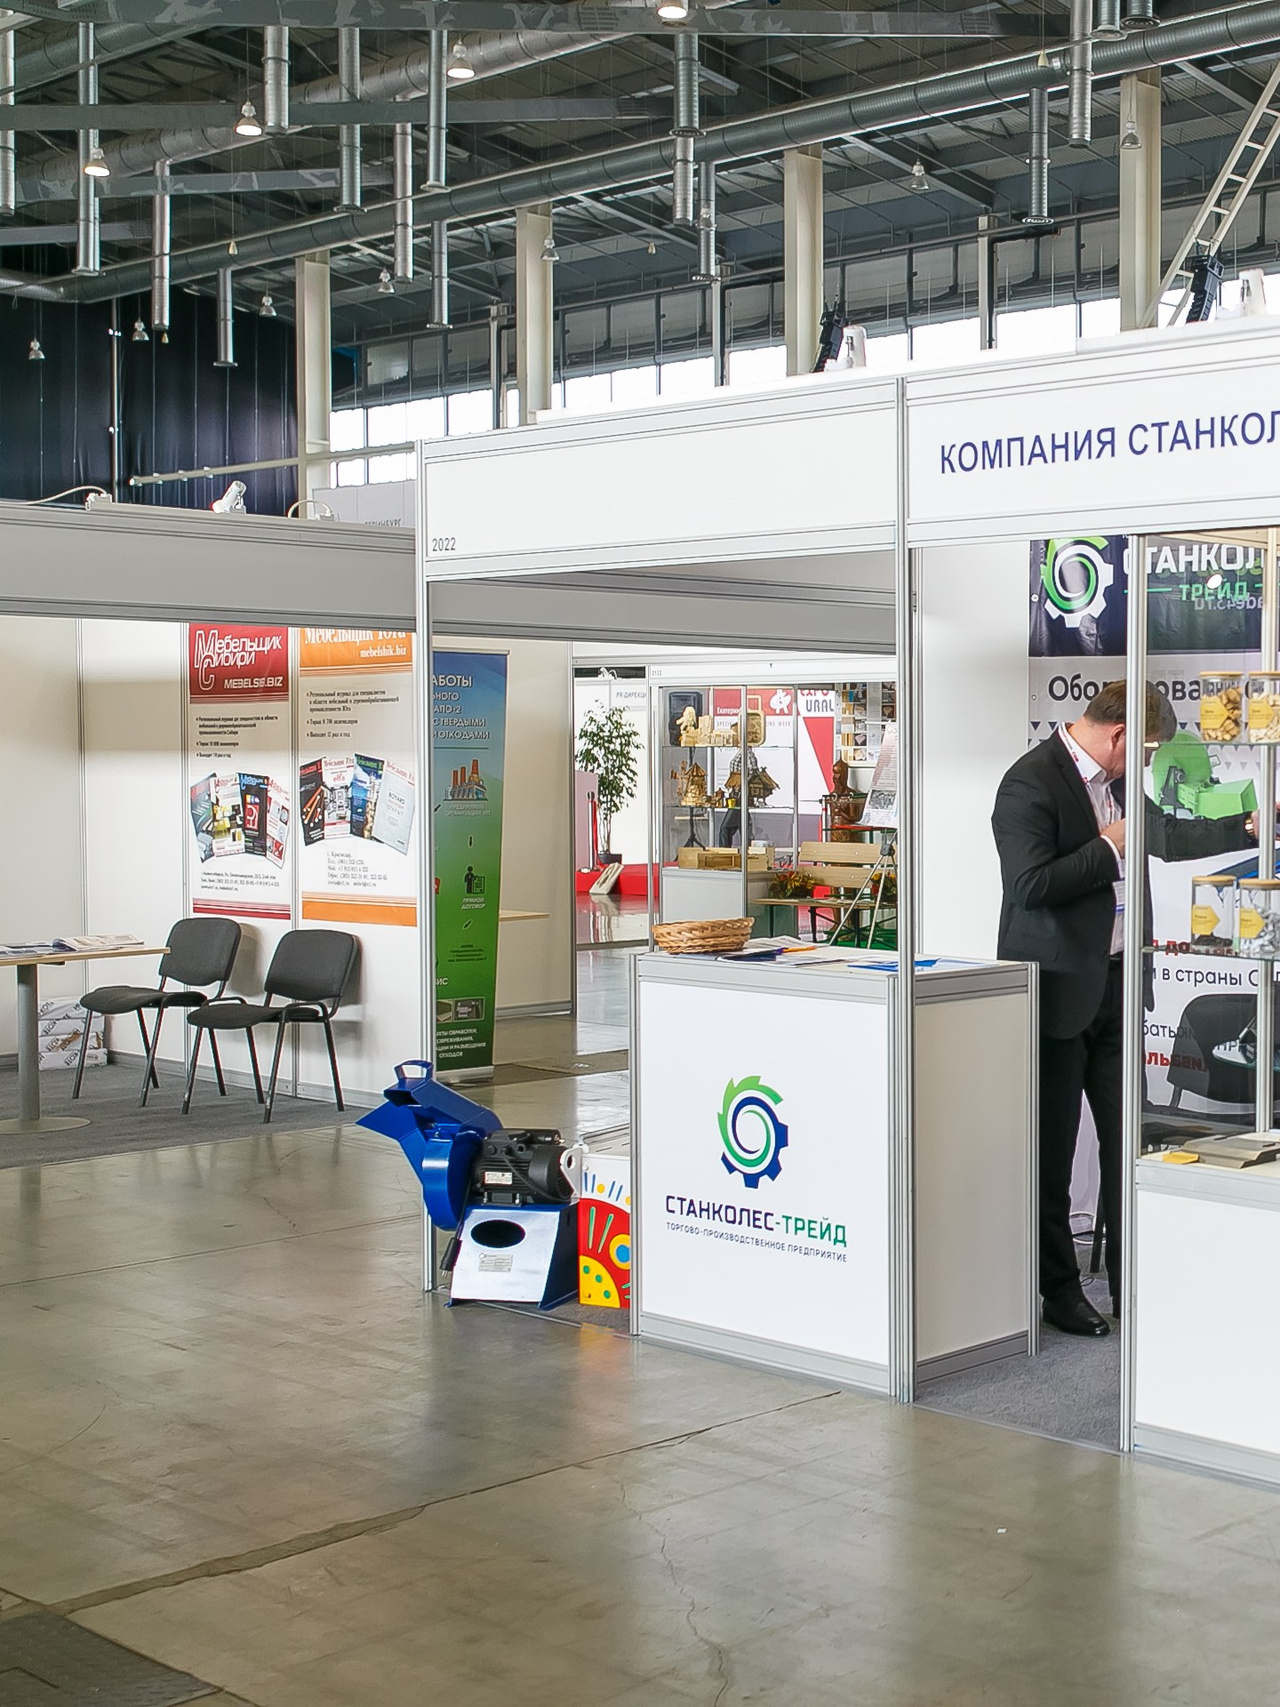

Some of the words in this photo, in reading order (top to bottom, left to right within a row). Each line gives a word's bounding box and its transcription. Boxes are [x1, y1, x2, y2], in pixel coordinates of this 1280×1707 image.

[940, 426, 1116, 474] КОМПАНИЯ
[431, 537, 456, 552] 2022
[360, 644, 407, 657] mebelshik.biz
[806, 699, 834, 713] URAL
[1175, 968, 1242, 988] страны
[665, 1194, 847, 1248] СТАНКОЛЕС-ТРЕЙД
[666, 1221, 786, 1251] ТОРГОВО-ПРОИЗВОДСТВЕННОЕ
[787, 1243, 848, 1263] ПРЕДПРИЯТИЕ
